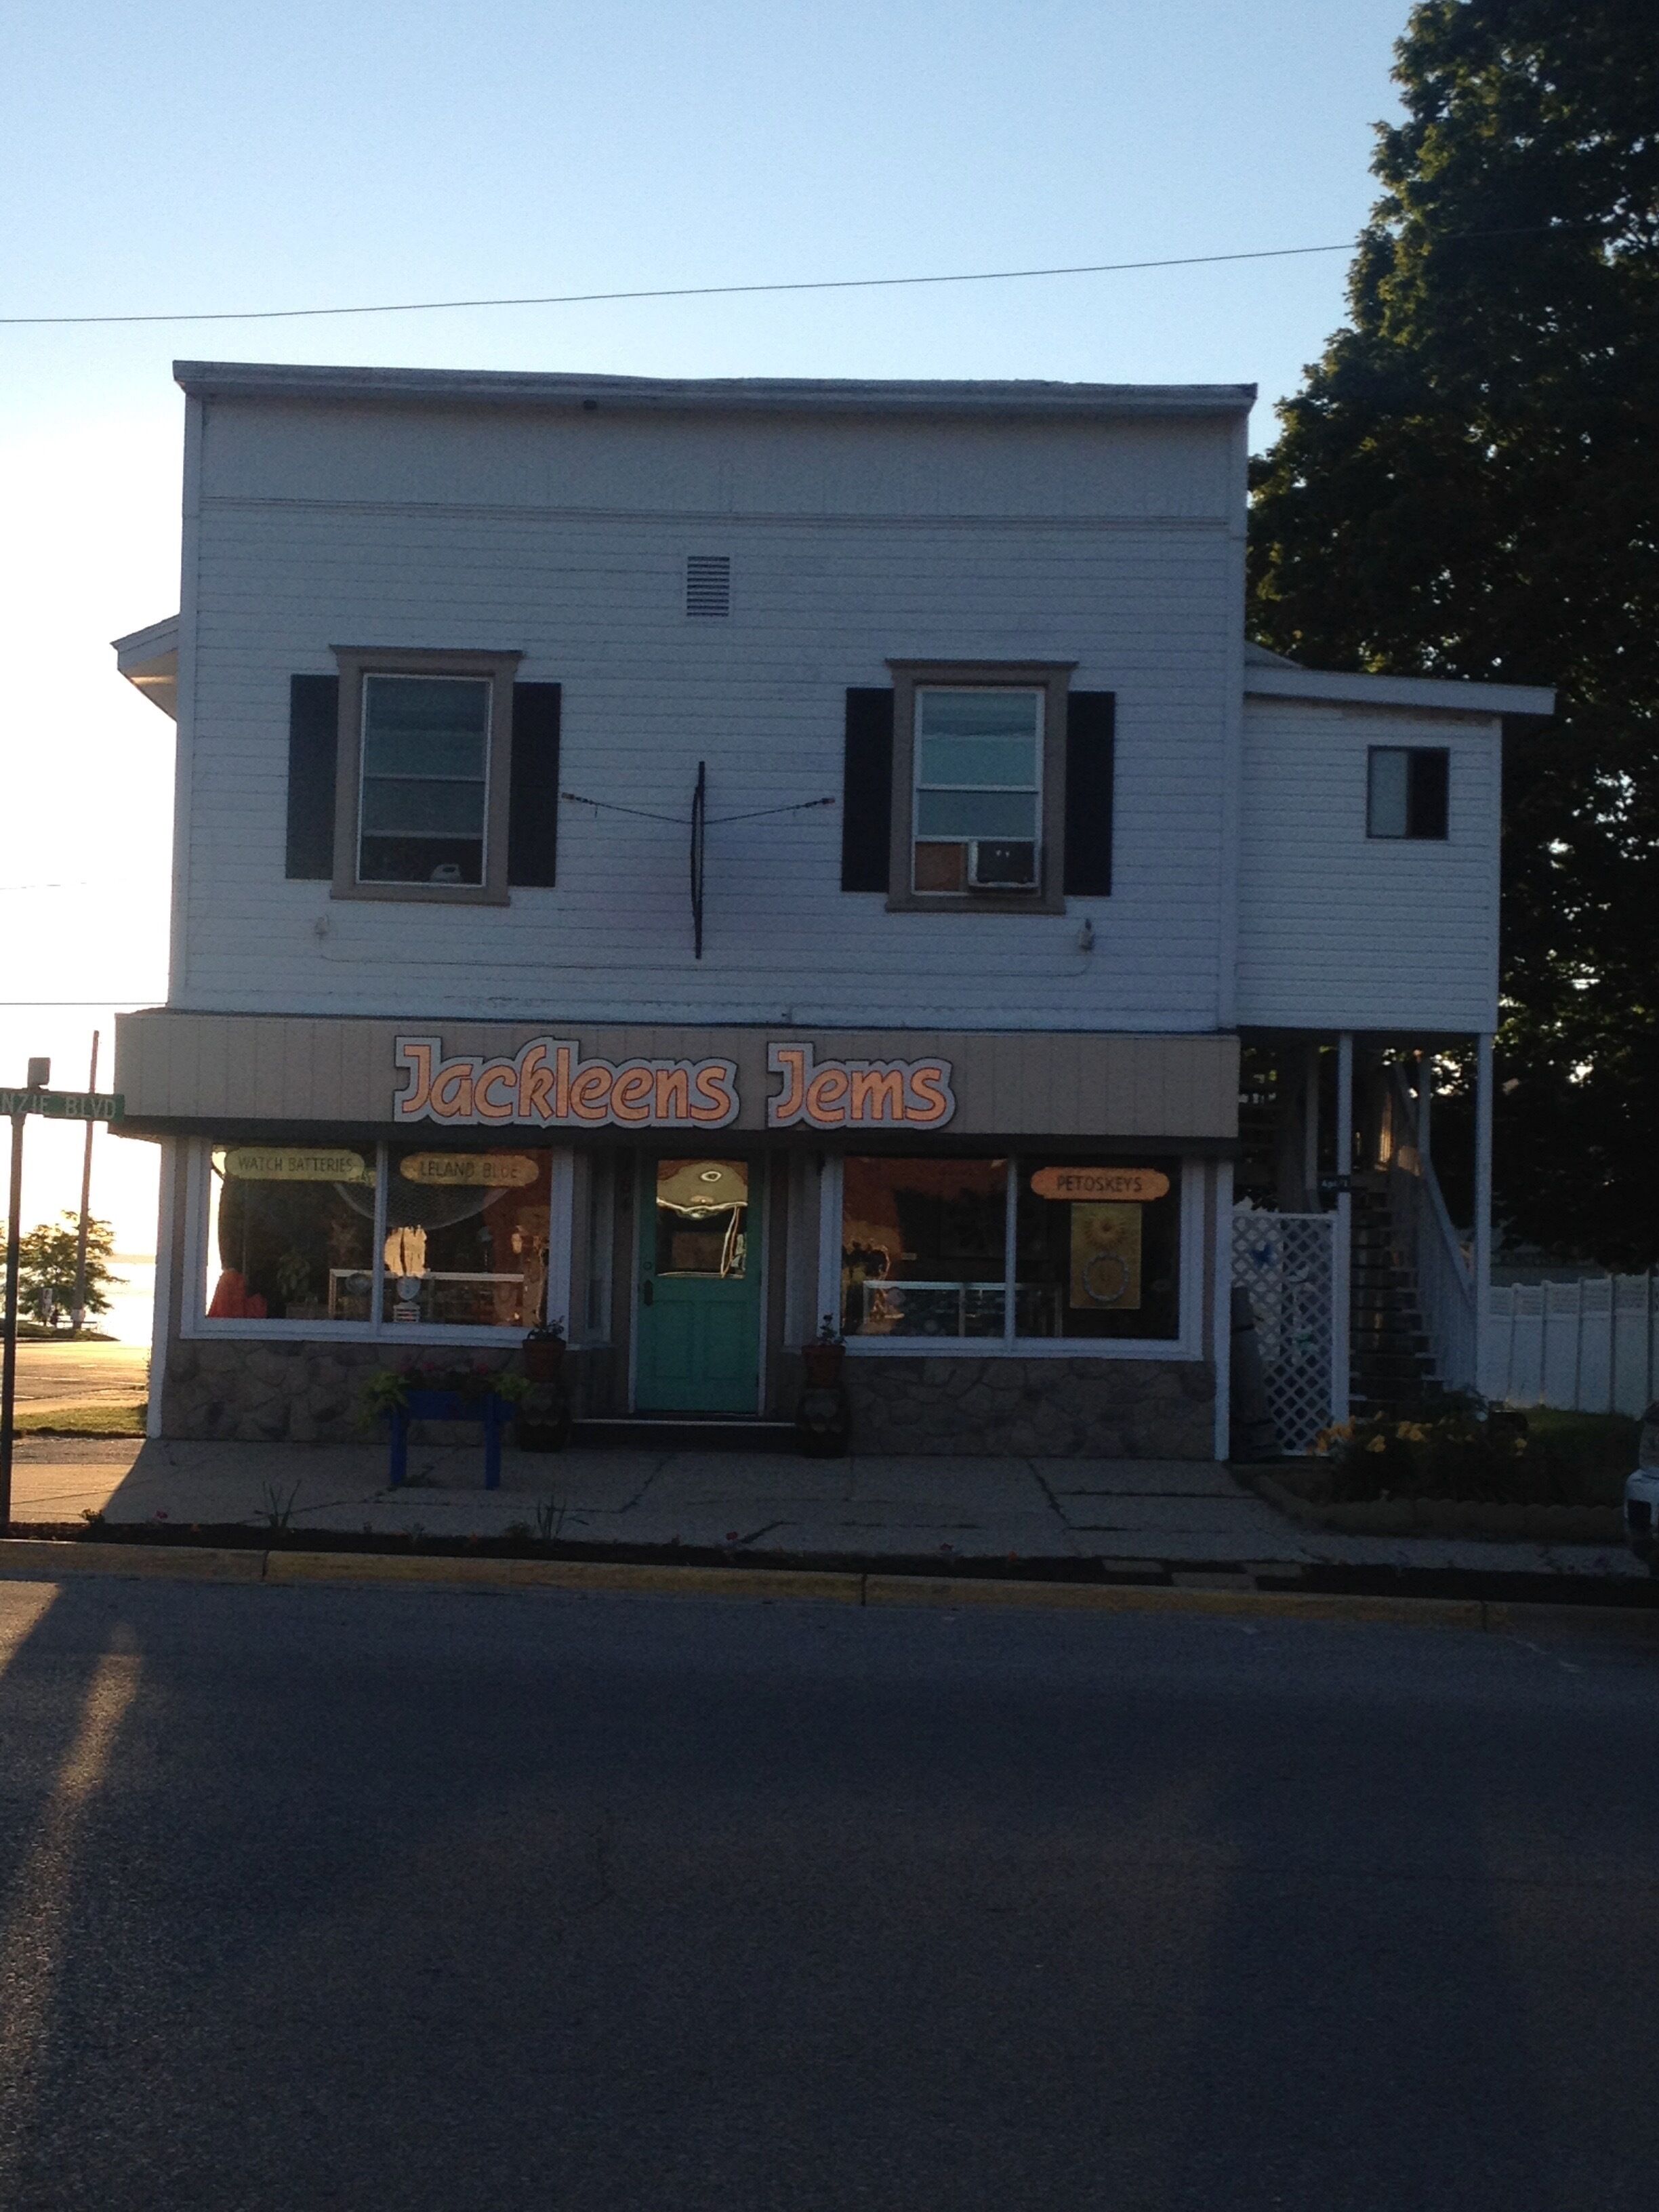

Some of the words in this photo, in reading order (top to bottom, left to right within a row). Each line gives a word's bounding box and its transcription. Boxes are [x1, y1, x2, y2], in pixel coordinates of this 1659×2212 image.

[401, 1042, 733, 1122] Jackleens
[775, 1048, 948, 1124] Jems
[65, 1097, 117, 1120] BLVD
[239, 1156, 283, 1171] WATCH
[288, 1157, 353, 1173] BATTERIES
[419, 1160, 475, 1178] LELAND
[483, 1162, 518, 1179] BLUE
[1057, 1175, 1143, 1193] PETOSKEYS
